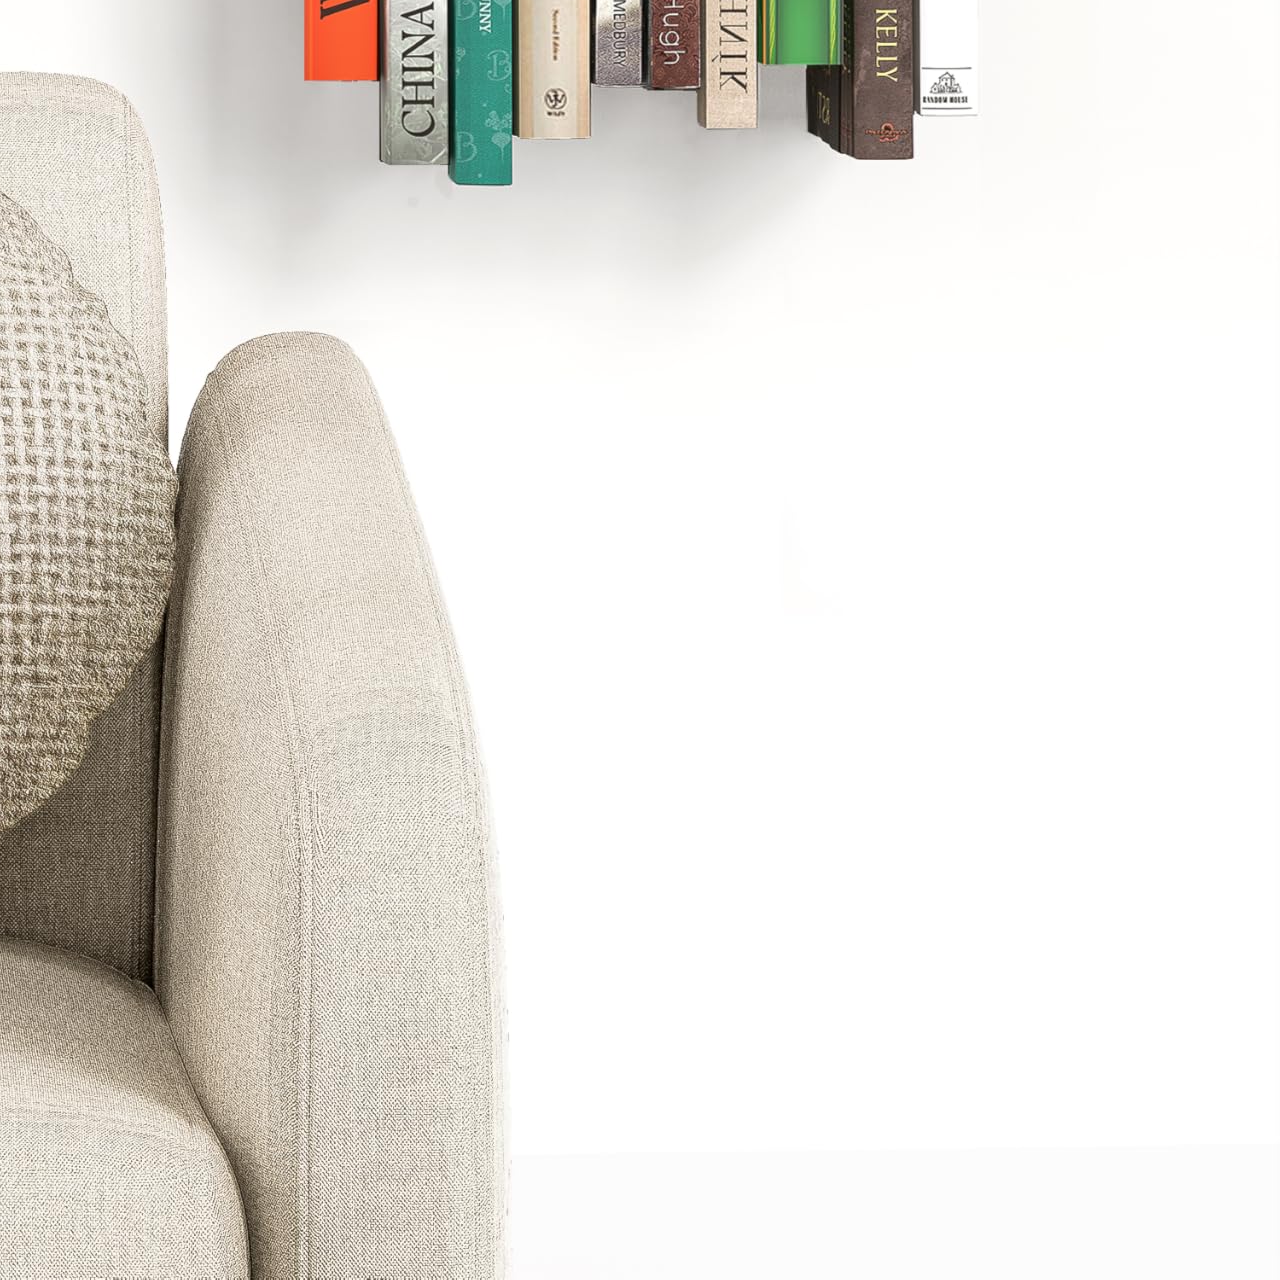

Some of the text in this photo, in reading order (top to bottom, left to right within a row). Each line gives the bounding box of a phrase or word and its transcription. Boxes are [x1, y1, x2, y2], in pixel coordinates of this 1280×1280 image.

[401, 1, 436, 138] CHINA
[613, 0, 627, 67] MEDBURY
[875, 8, 898, 82] KELLY
